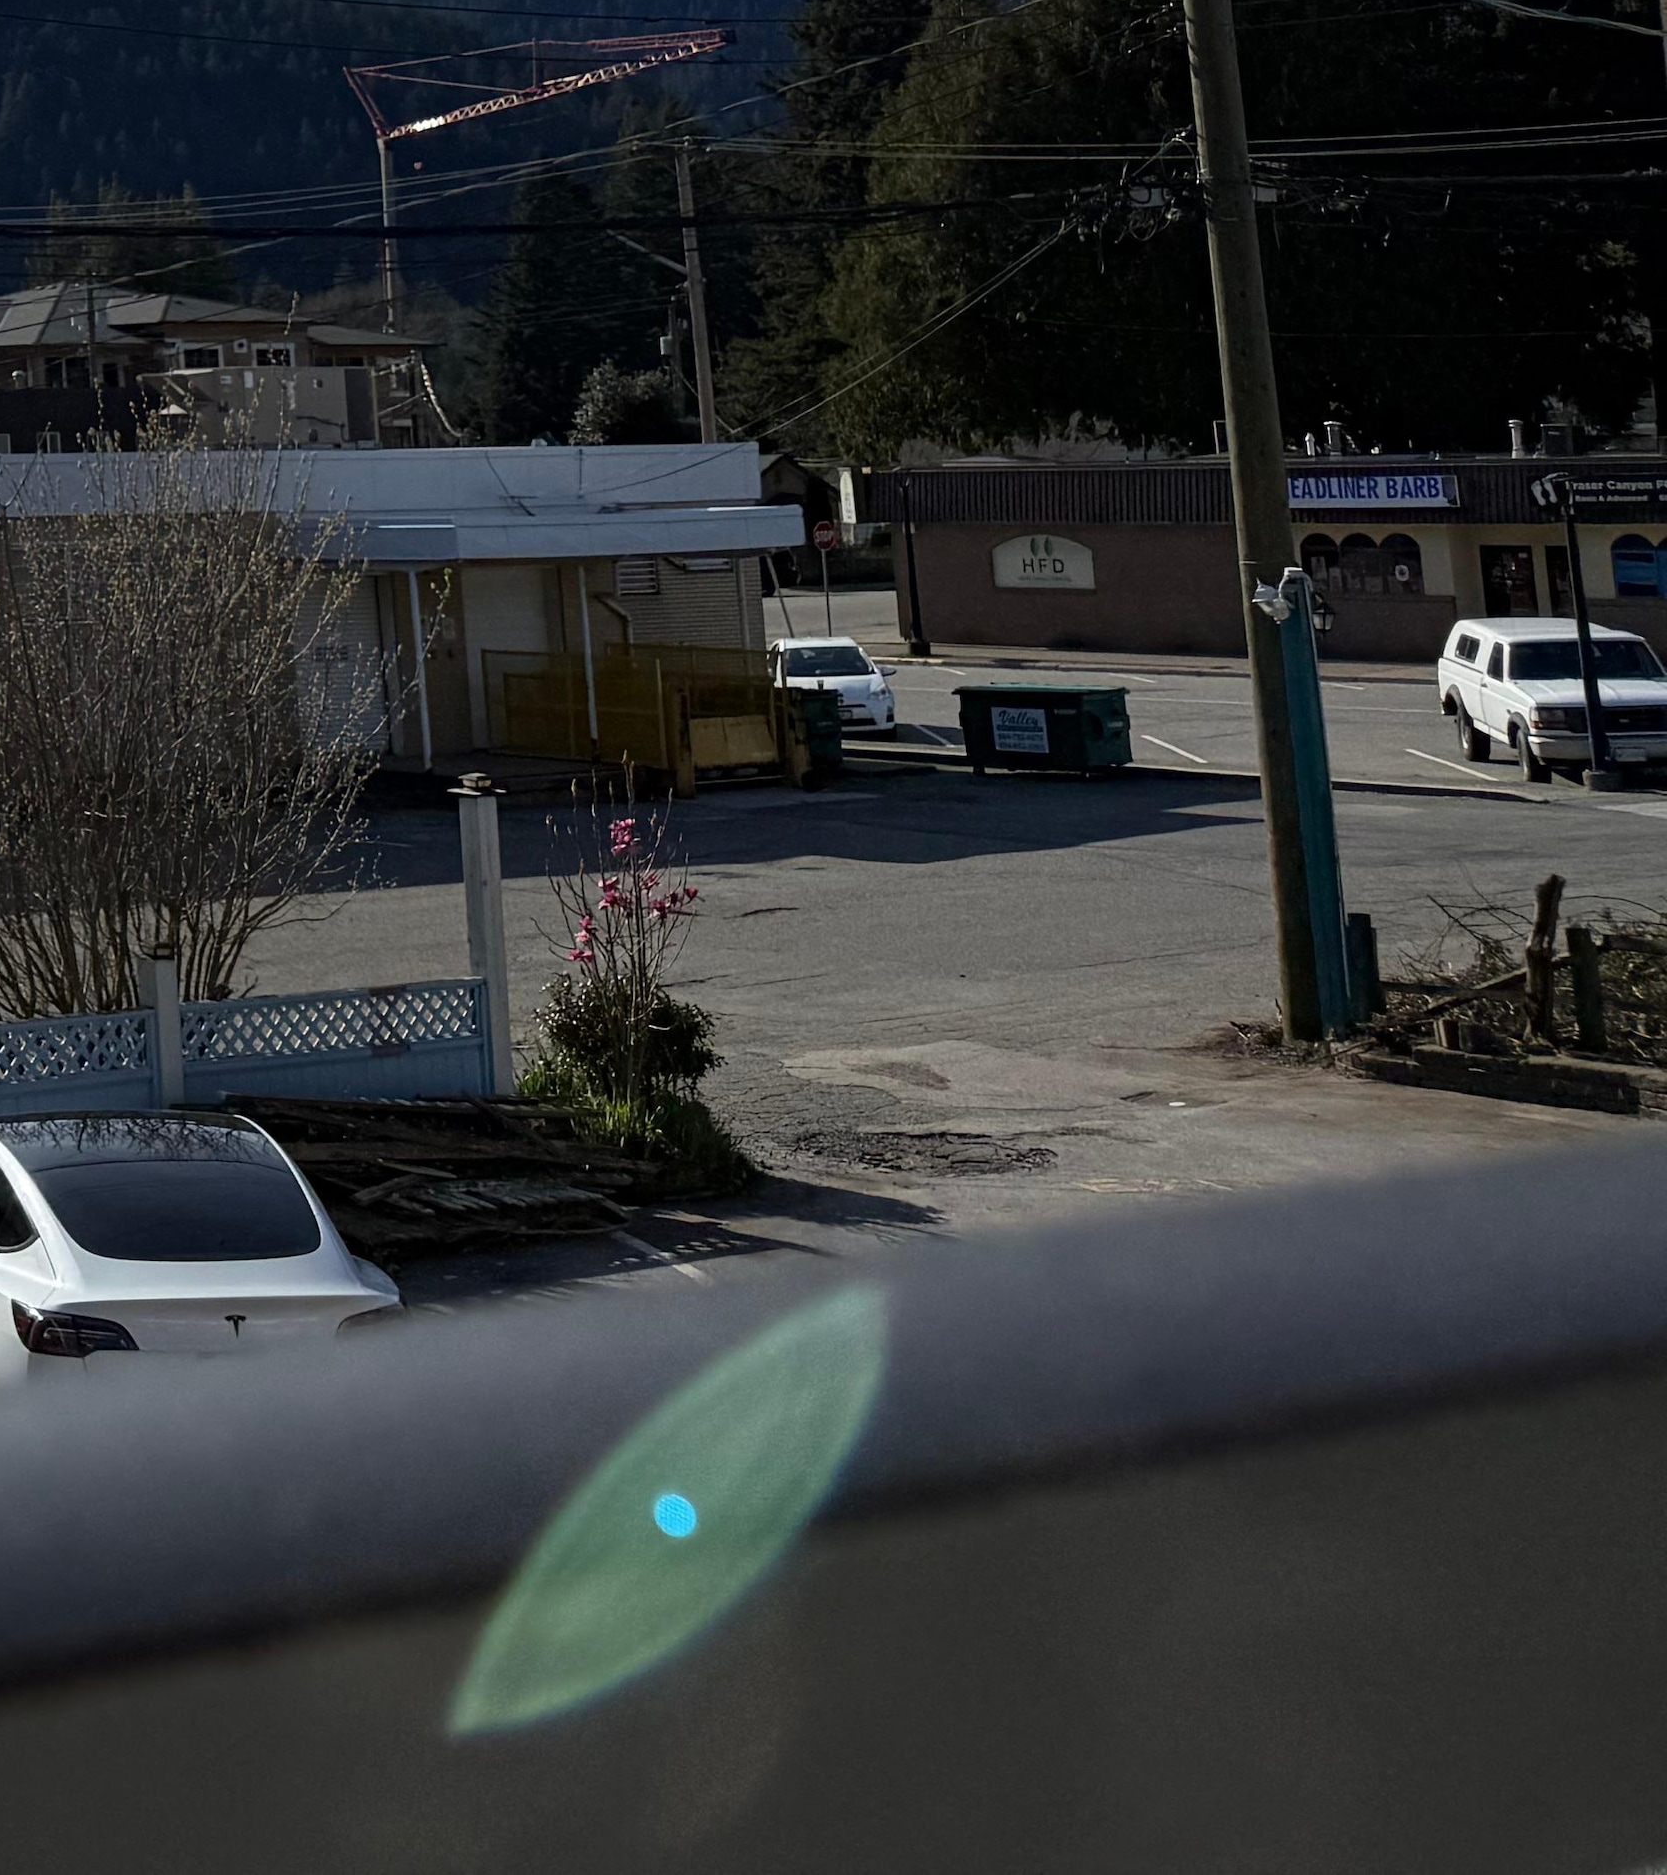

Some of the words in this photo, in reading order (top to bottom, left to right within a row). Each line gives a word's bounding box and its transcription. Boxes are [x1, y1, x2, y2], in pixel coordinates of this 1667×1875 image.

[1291, 477, 1379, 499] EADLINER
[1606, 480, 1653, 491] Canyon
[1022, 558, 1064, 573] HFD
[999, 710, 1038, 725] Valley
